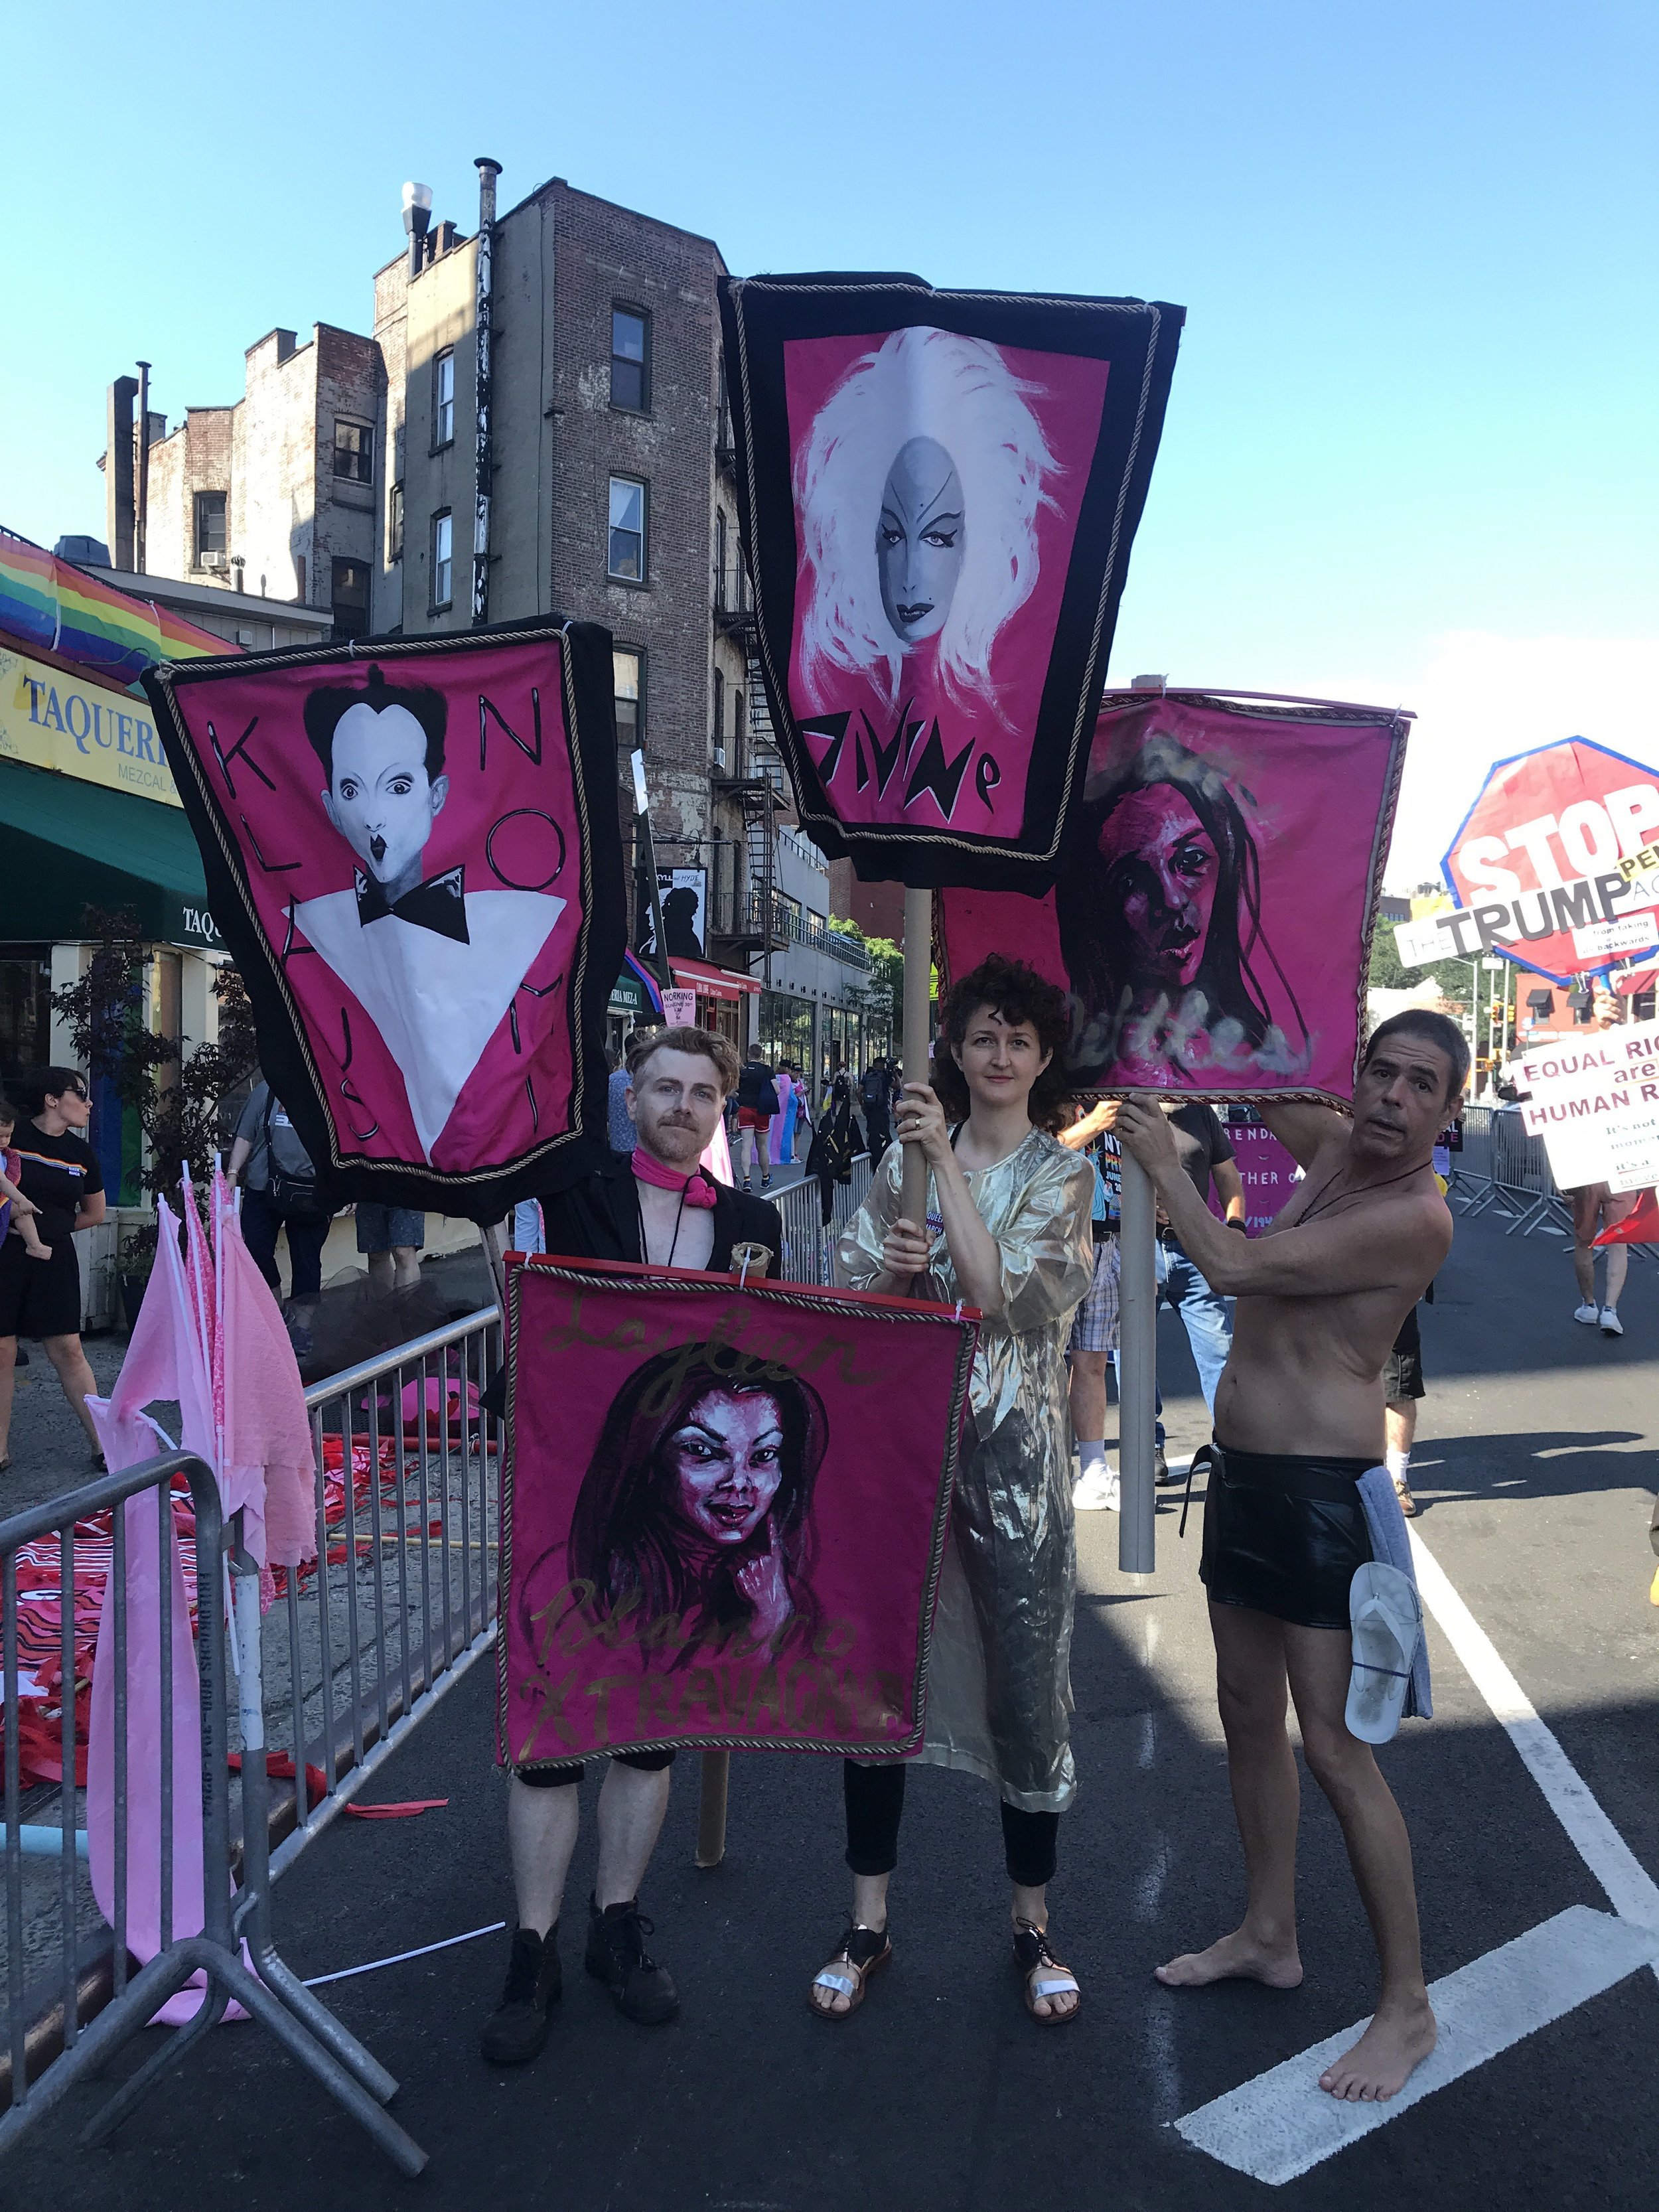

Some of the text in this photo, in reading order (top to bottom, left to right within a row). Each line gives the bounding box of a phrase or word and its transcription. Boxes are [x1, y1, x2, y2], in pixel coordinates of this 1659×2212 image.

[118, 764, 167, 792] MEZCAL
[1458, 783, 1659, 897] STOP
[1436, 873, 1631, 954] TRUMP
[1618, 921, 1649, 931] taking
[1598, 936, 1650, 951] backwards
[1524, 1050, 1615, 1082] EQUAL
[1614, 1063, 1656, 1084] are
[1529, 1090, 1630, 1125] HUMAN
[1632, 1118, 1656, 1130] not
[1104, 1131, 1121, 1155] NY
[1106, 1171, 1121, 1183] JUNE
